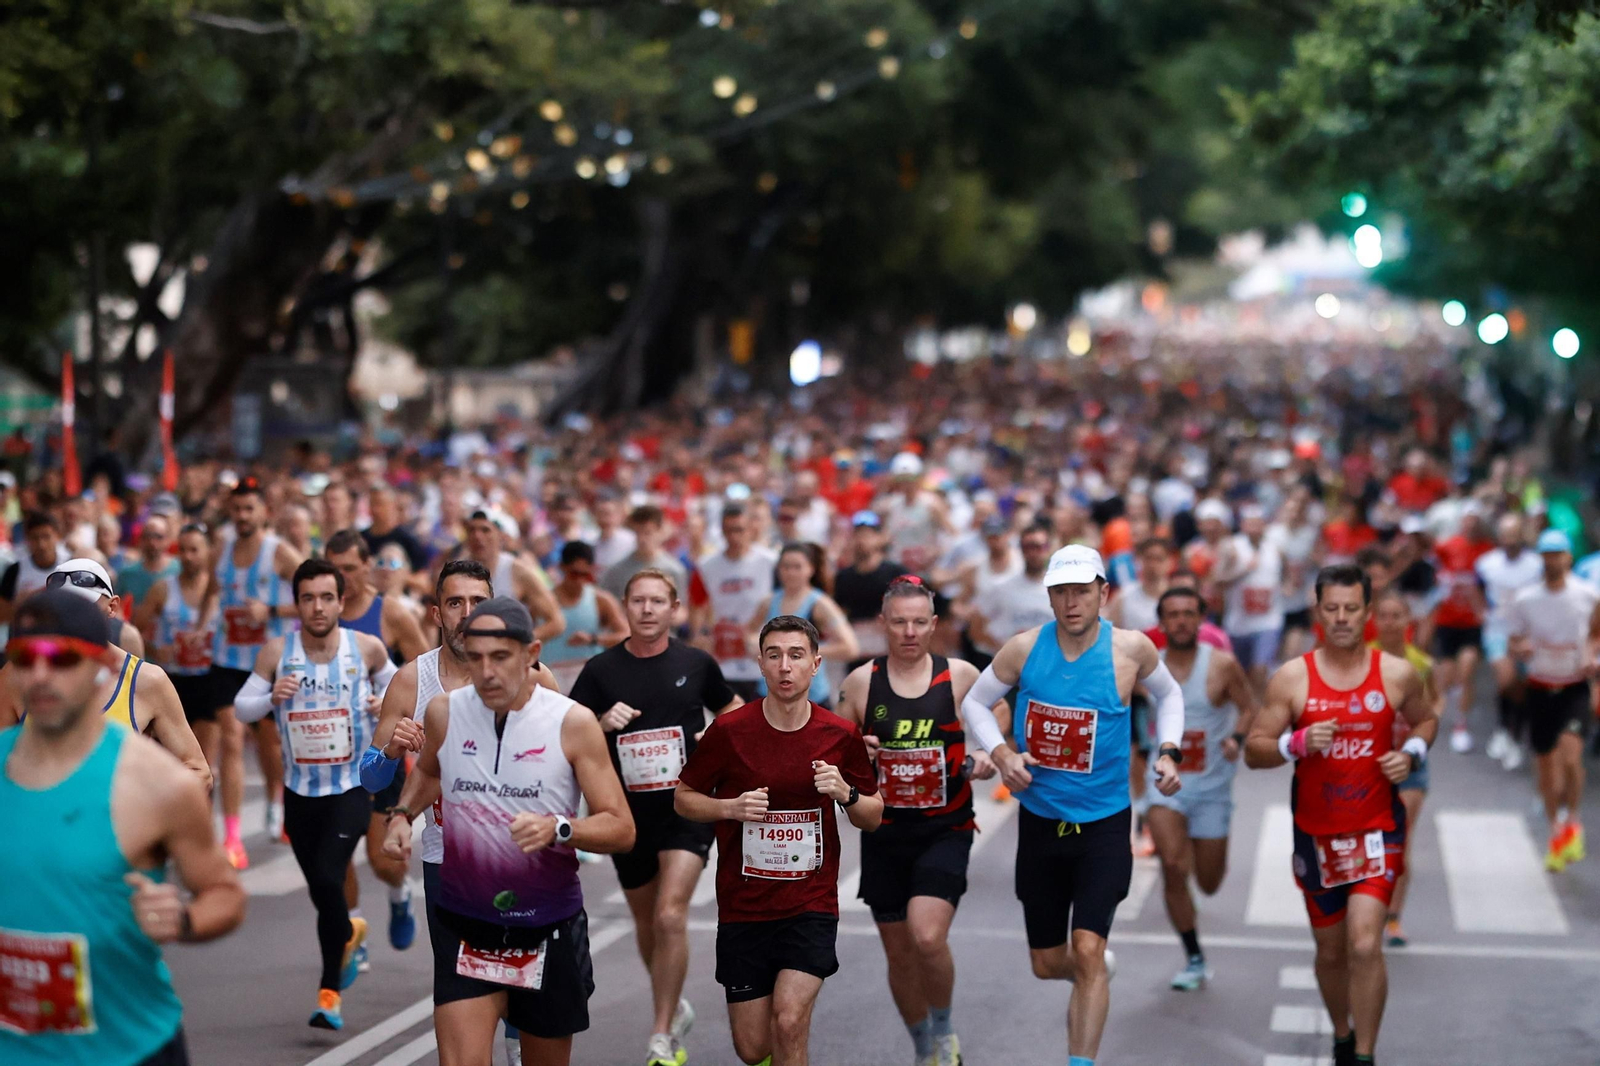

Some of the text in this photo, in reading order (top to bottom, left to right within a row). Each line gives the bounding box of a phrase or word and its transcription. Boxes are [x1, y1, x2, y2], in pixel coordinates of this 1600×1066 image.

[301, 723, 336, 736] 15061
[1043, 721, 1069, 736] 937
[631, 745, 669, 758] 14995
[891, 764, 925, 776] 2066
[764, 813, 811, 823] GENERALI
[758, 828, 803, 842] 14990
